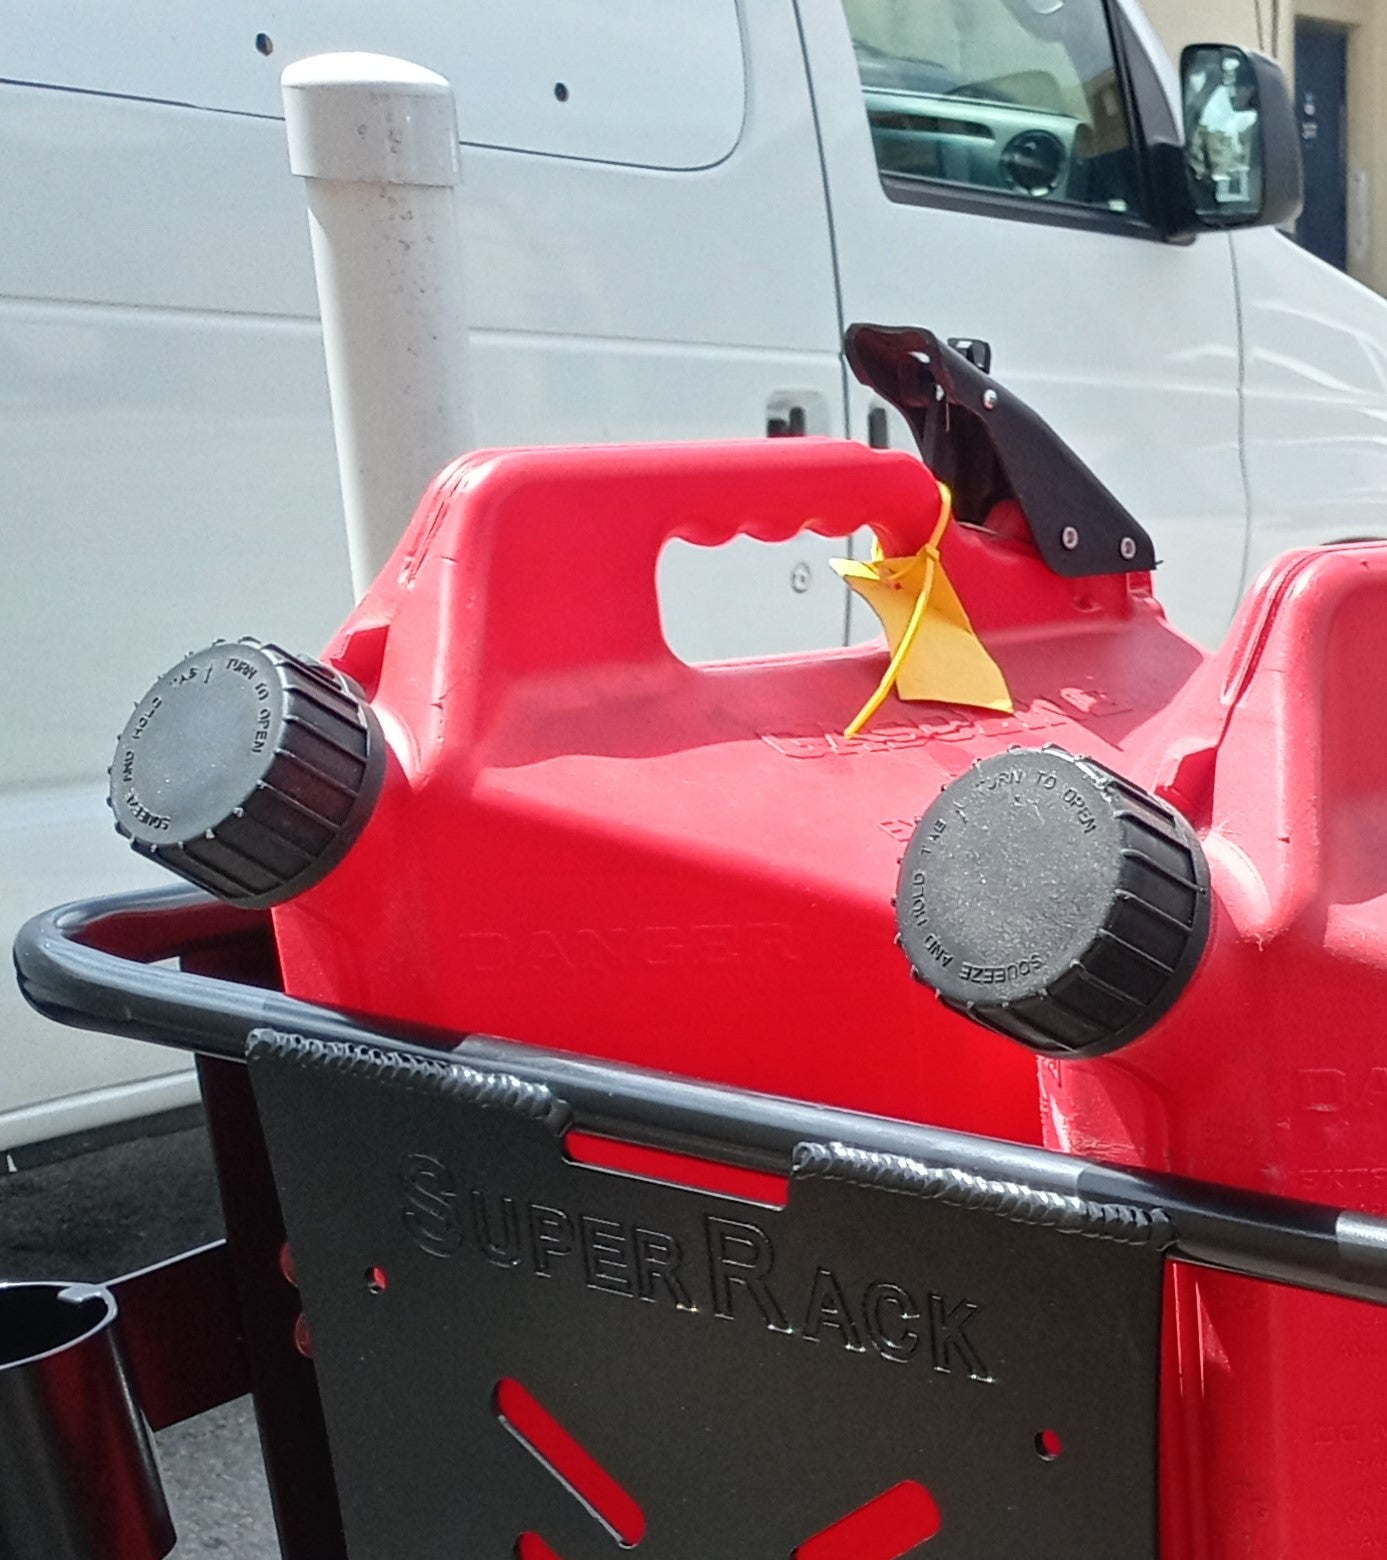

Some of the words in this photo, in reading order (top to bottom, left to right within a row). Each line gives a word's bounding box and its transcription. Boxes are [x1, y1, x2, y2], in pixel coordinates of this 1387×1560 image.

[251, 708, 272, 753] OPEN
[1035, 769, 1058, 790] TO
[1062, 788, 1097, 836] OPEN
[912, 871, 930, 927] HOLD
[923, 933, 955, 968] AND
[957, 953, 1045, 984] SQUEEZE
